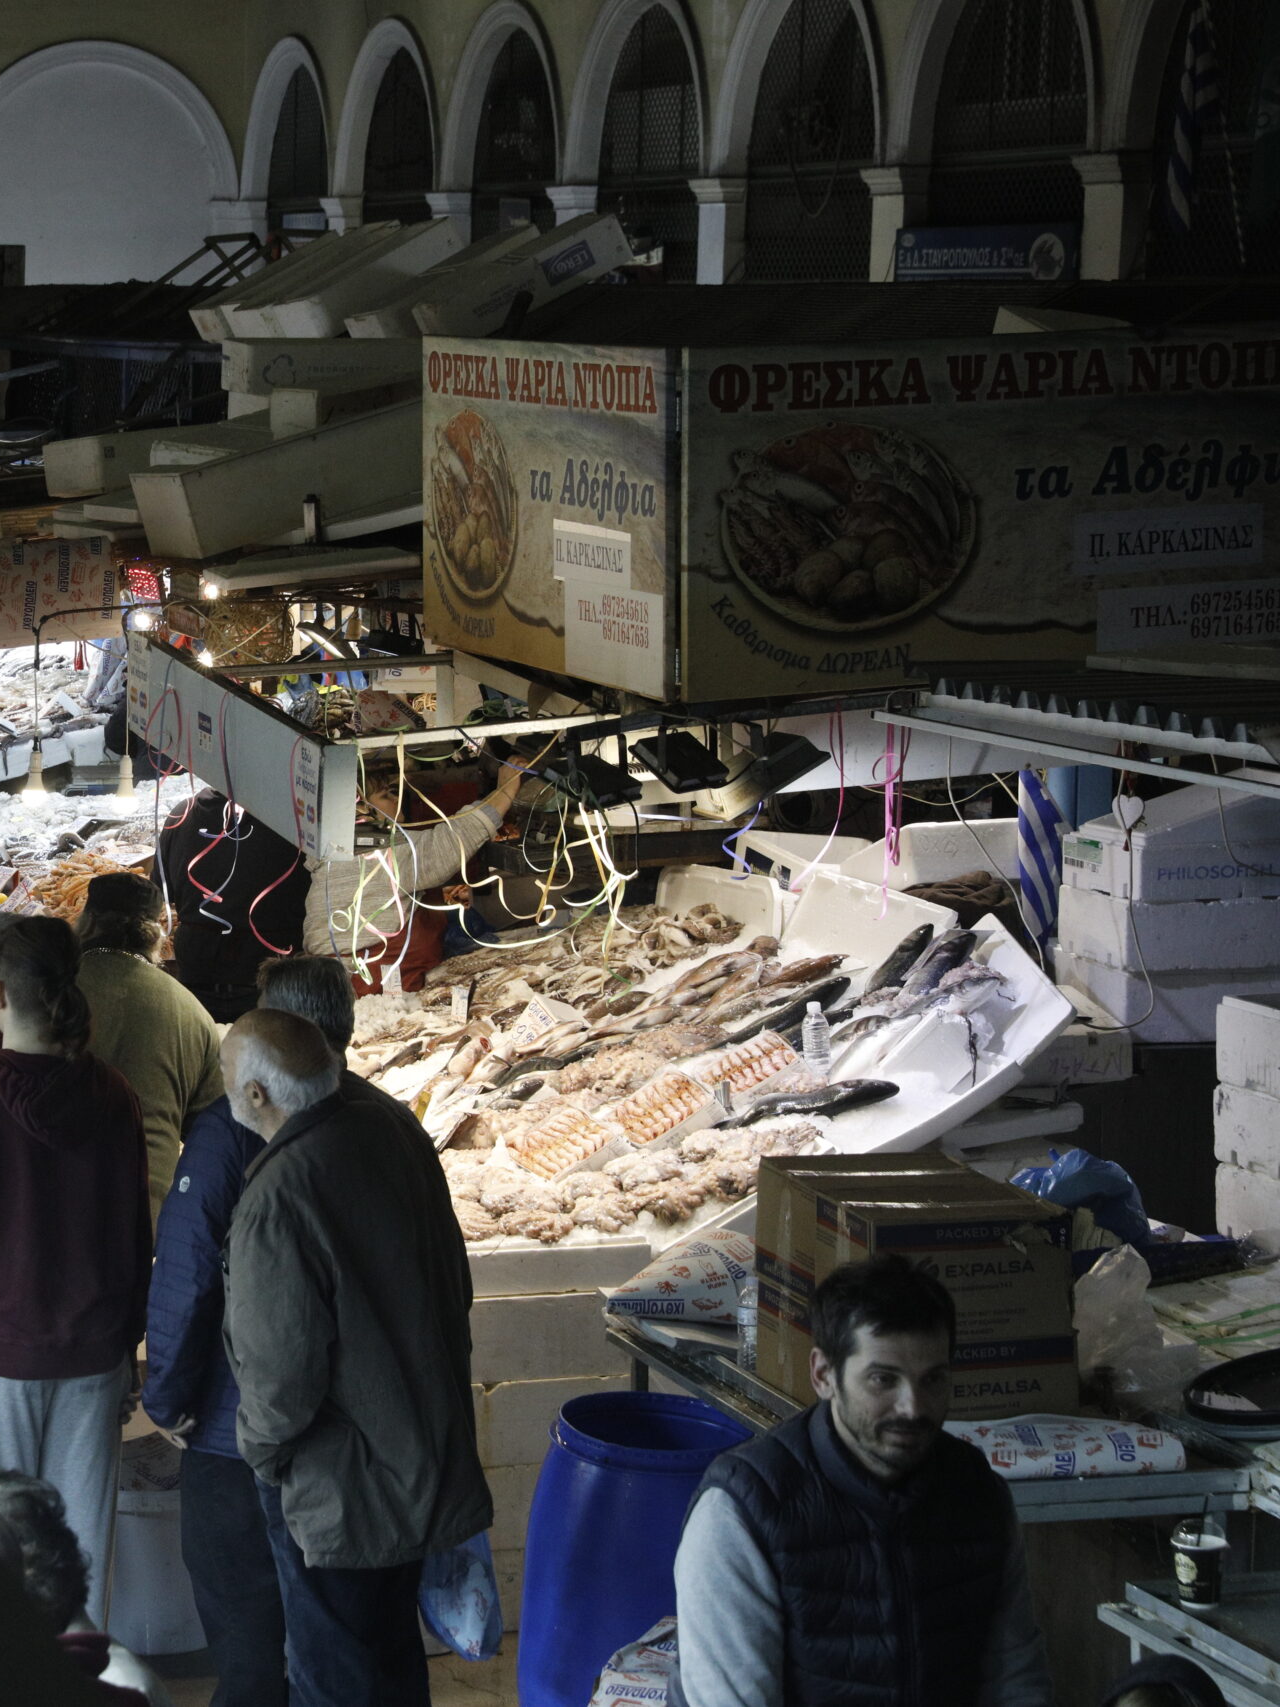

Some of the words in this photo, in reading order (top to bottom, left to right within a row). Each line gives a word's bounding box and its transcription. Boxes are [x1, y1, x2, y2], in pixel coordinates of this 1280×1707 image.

[428, 351, 501, 400] ΦΡΕΣΚΑ
[505, 357, 568, 407] ΨΑΡΙΑ
[573, 362, 657, 414] ΝΤΟΠΙΑ
[708, 357, 931, 413] ΦΡΕΣΚΑ
[947, 349, 1114, 401] ΨΑΡΙΑ
[530, 469, 552, 502] τα
[560, 458, 657, 525] Αδέλφια
[1015, 465, 1073, 501] τα
[566, 540, 624, 573] ΚΑΡΚΑΣΙΝΑΣ
[1089, 533, 1111, 558] Π.
[22, 580, 37, 630] ΙΧΘΥΟΠΩΛΕΙΟ
[101, 570, 115, 619] ΙΧΥΟΠΩΛΕΙΟ
[602, 594, 649, 624] 6972545618
[602, 623, 649, 649] 6971647653
[710, 594, 811, 670] Καθάρισμα
[816, 643, 911, 674] ΔΩΡΕΑΝ
[1157, 863, 1273, 881] PHILOSOFISH
[935, 1226, 988, 1239] PACKED
[945, 1259, 1035, 1278] EXPALSA
[954, 1347, 995, 1361] ACKED
[998, 1345, 1017, 1359] BY
[953, 1379, 1041, 1398] EXPALSA
